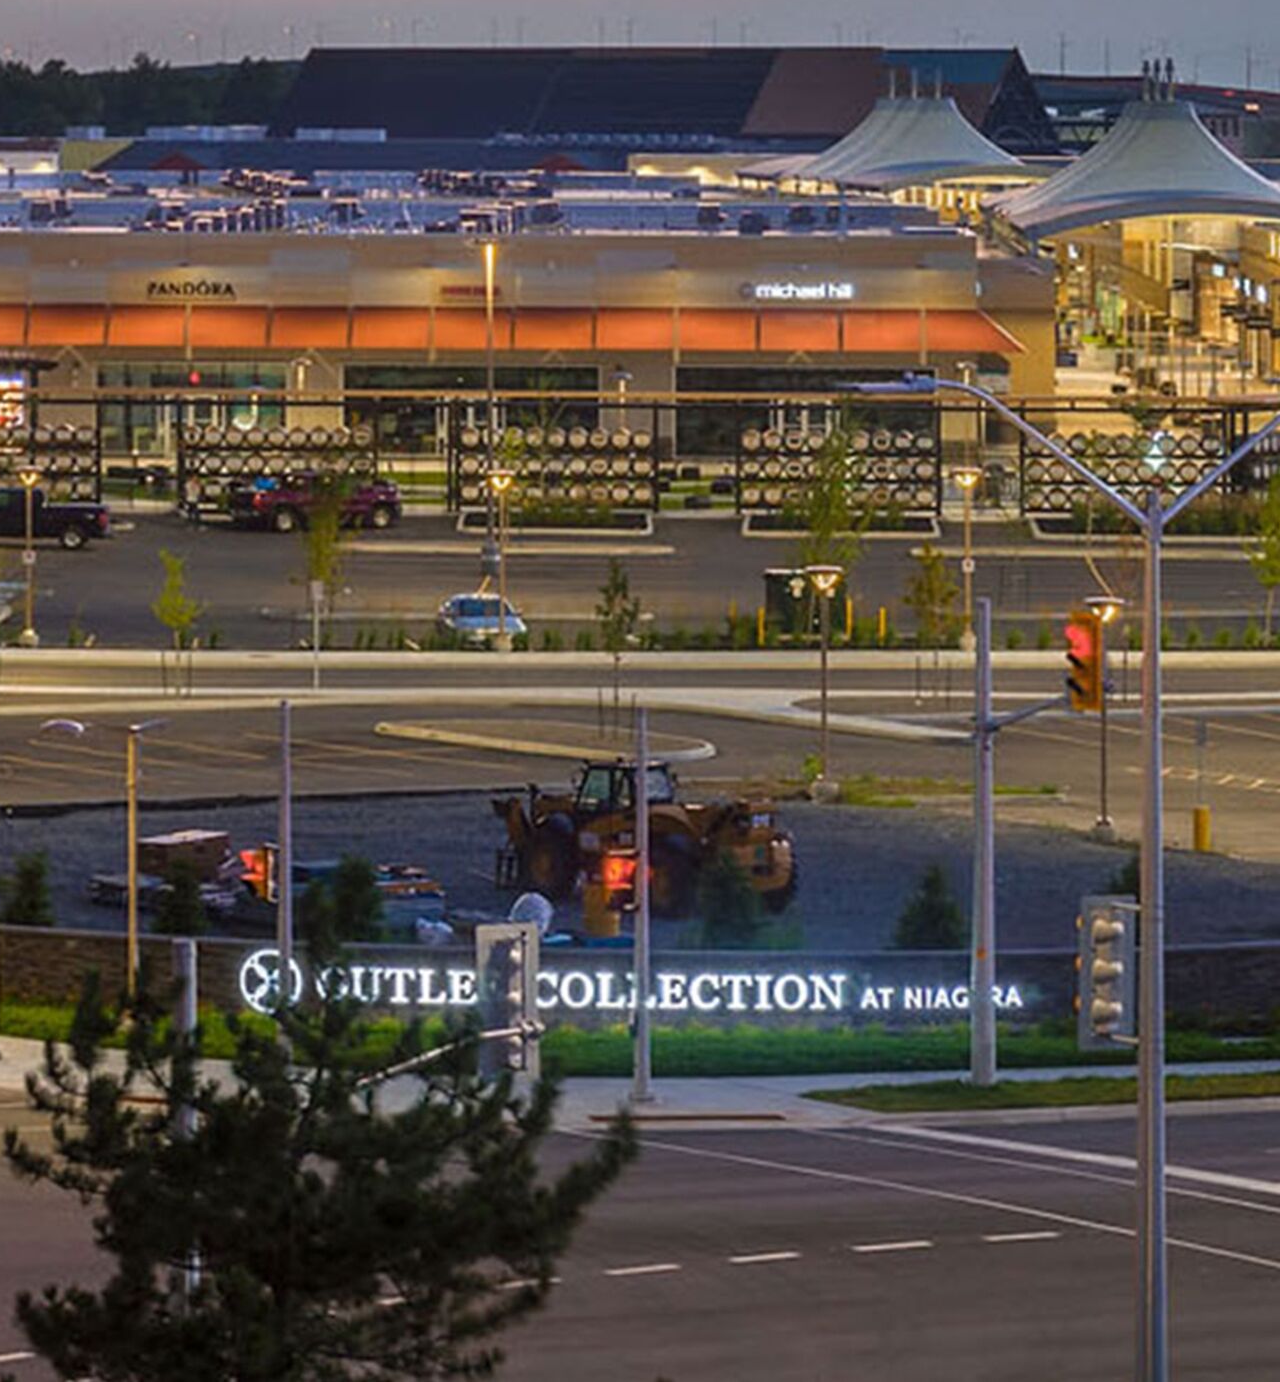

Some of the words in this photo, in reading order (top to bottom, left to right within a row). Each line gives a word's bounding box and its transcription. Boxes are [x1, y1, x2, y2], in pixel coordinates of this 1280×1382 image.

[147, 280, 236, 295] PANDORA
[755, 282, 825, 298] michael
[828, 282, 852, 298] hill
[860, 987, 894, 1009] AT
[904, 986, 1023, 1009] NIAGRA
